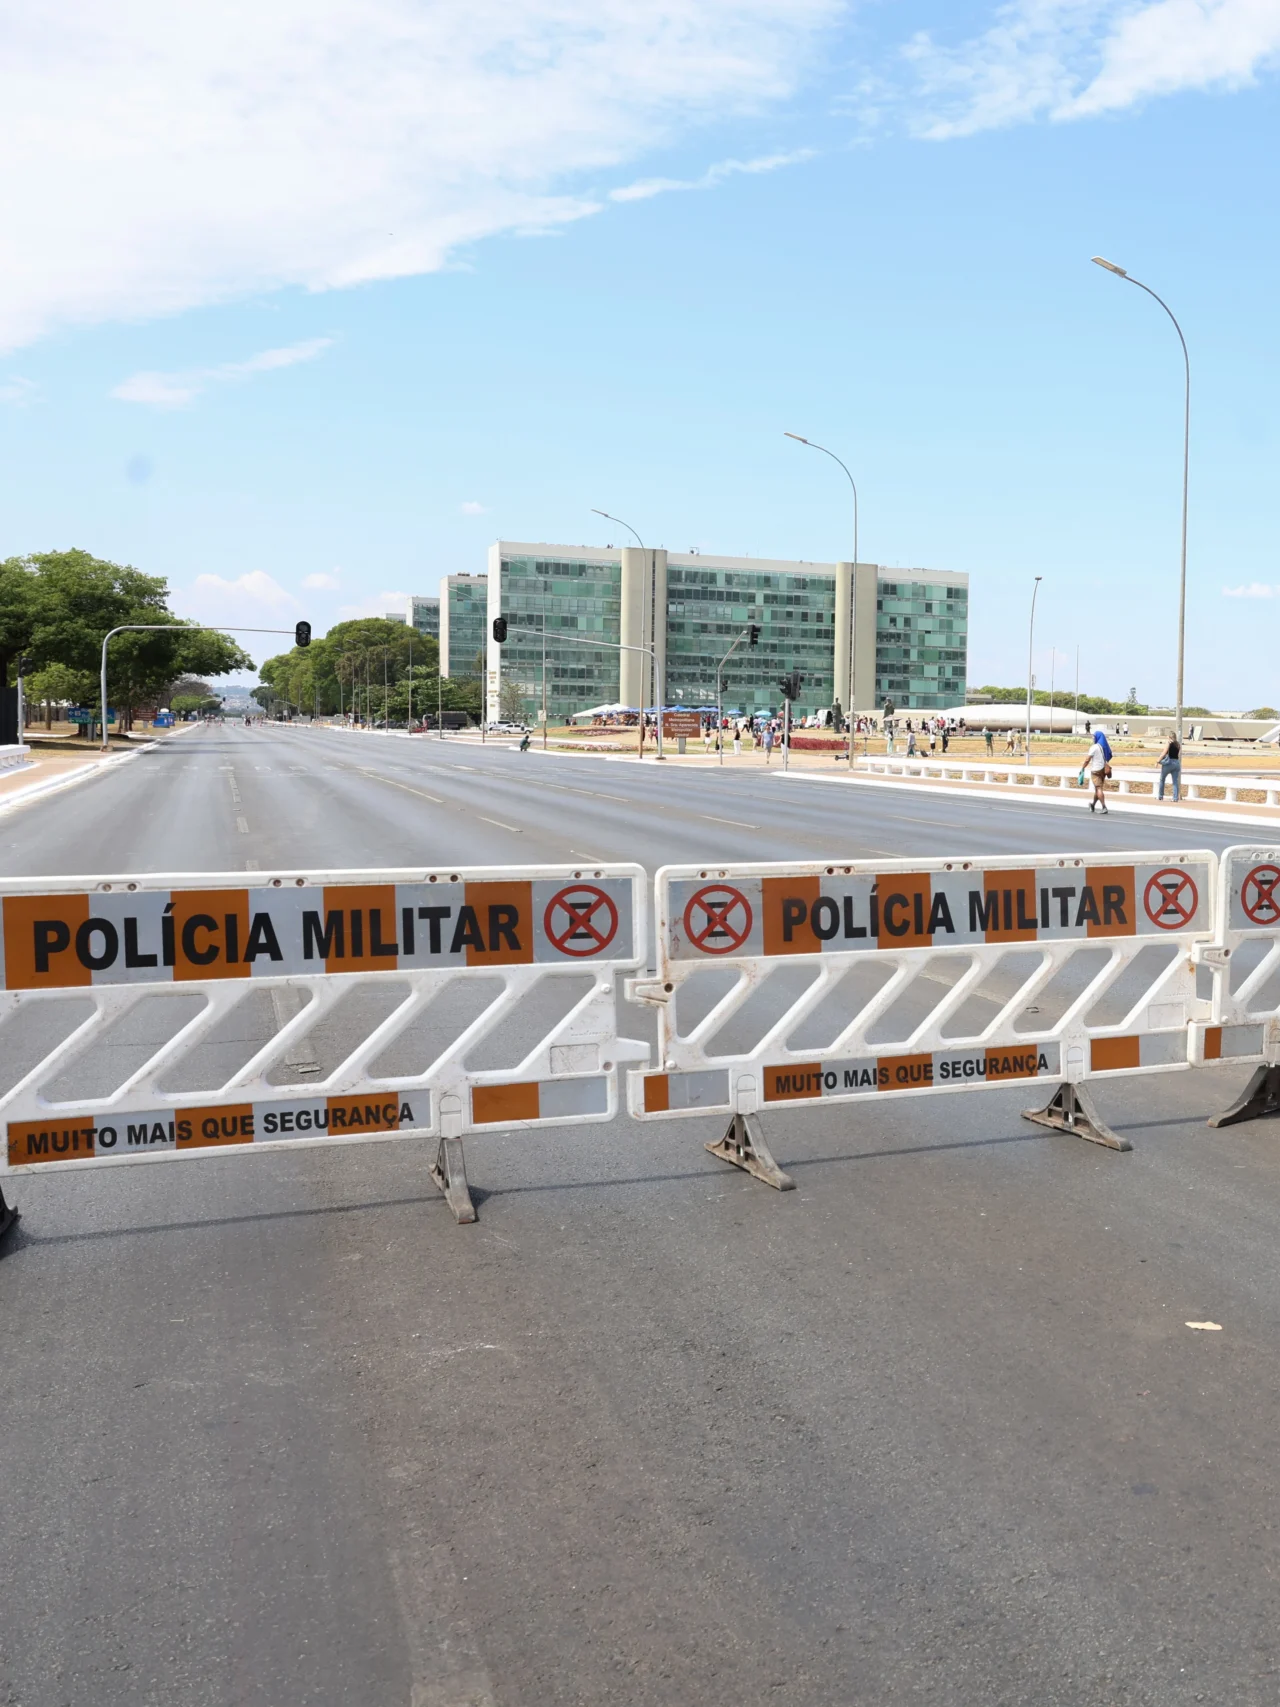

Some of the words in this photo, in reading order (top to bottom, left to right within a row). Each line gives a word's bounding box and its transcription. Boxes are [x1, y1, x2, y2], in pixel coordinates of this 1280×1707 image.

[33, 902, 283, 973] POLÍCIA
[302, 904, 522, 960] MILITAR
[782, 884, 955, 942] POLÍCIA
[968, 885, 1128, 932] MILITAR
[775, 1071, 838, 1094] MUITO
[844, 1067, 889, 1088] MAIS
[896, 1063, 933, 1083] QUE
[939, 1053, 1049, 1079] SEGURANÇA
[27, 1127, 117, 1155] MUITO
[127, 1120, 193, 1146] MAIS
[202, 1115, 254, 1140] QUE
[263, 1102, 414, 1134] SEGURANÇA
